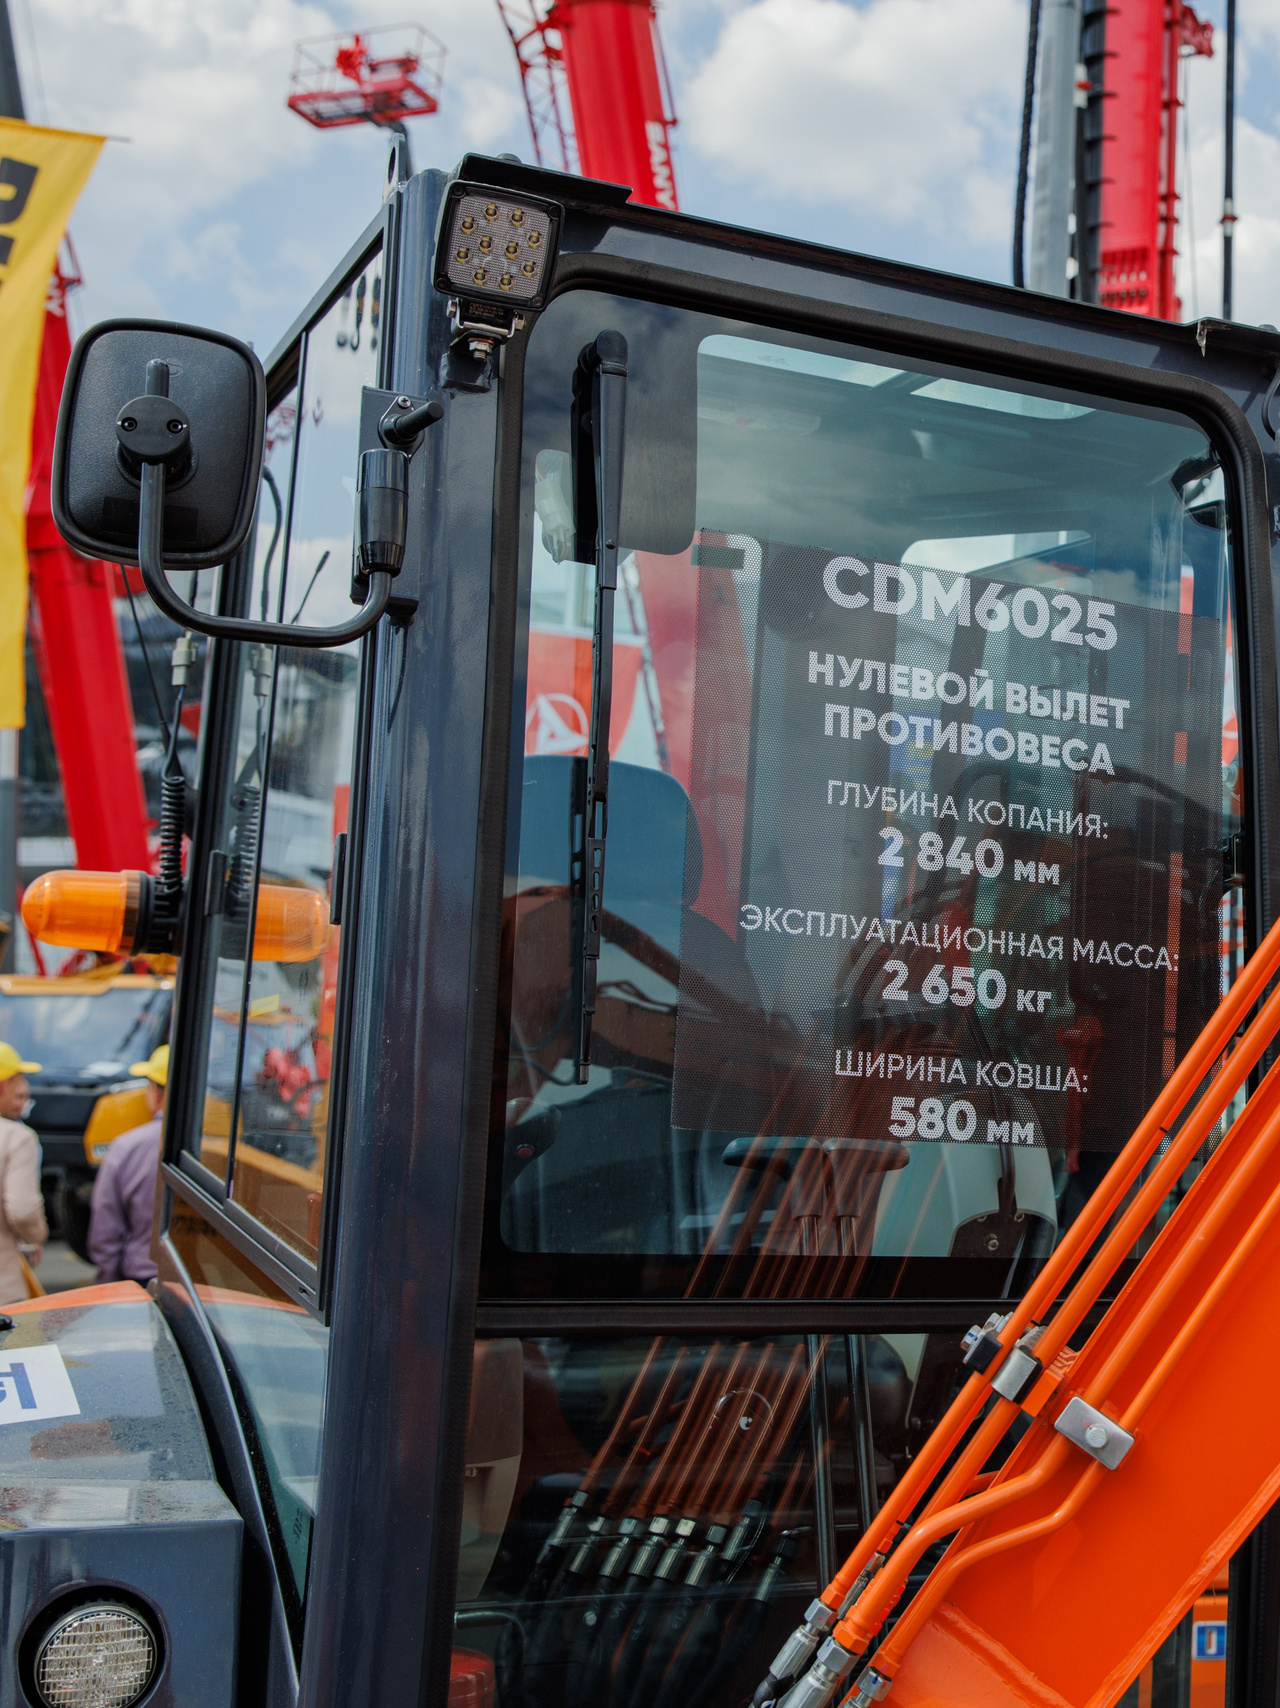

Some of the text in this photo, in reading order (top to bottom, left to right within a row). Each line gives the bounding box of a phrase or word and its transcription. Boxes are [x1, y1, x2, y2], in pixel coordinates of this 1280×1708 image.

[822, 555, 1118, 651] CDM6025
[807, 650, 1130, 730] НУЛЕВОЙ ВЫЛЕТ
[824, 703, 1116, 776] ПРОТИВОВЕСА
[827, 780, 1109, 839] ГЛУБИНА КОПАНИЯ:
[878, 826, 904, 867] 2
[917, 834, 1004, 878] 840
[740, 903, 1180, 972] ЭКСПЛУАТАЦИОННАЯ МАССА:
[881, 959, 909, 1001] 2
[921, 963, 1007, 1010] 650
[835, 1049, 1089, 1094] ШИРИНА КОВША:
[888, 1095, 977, 1141] 580
